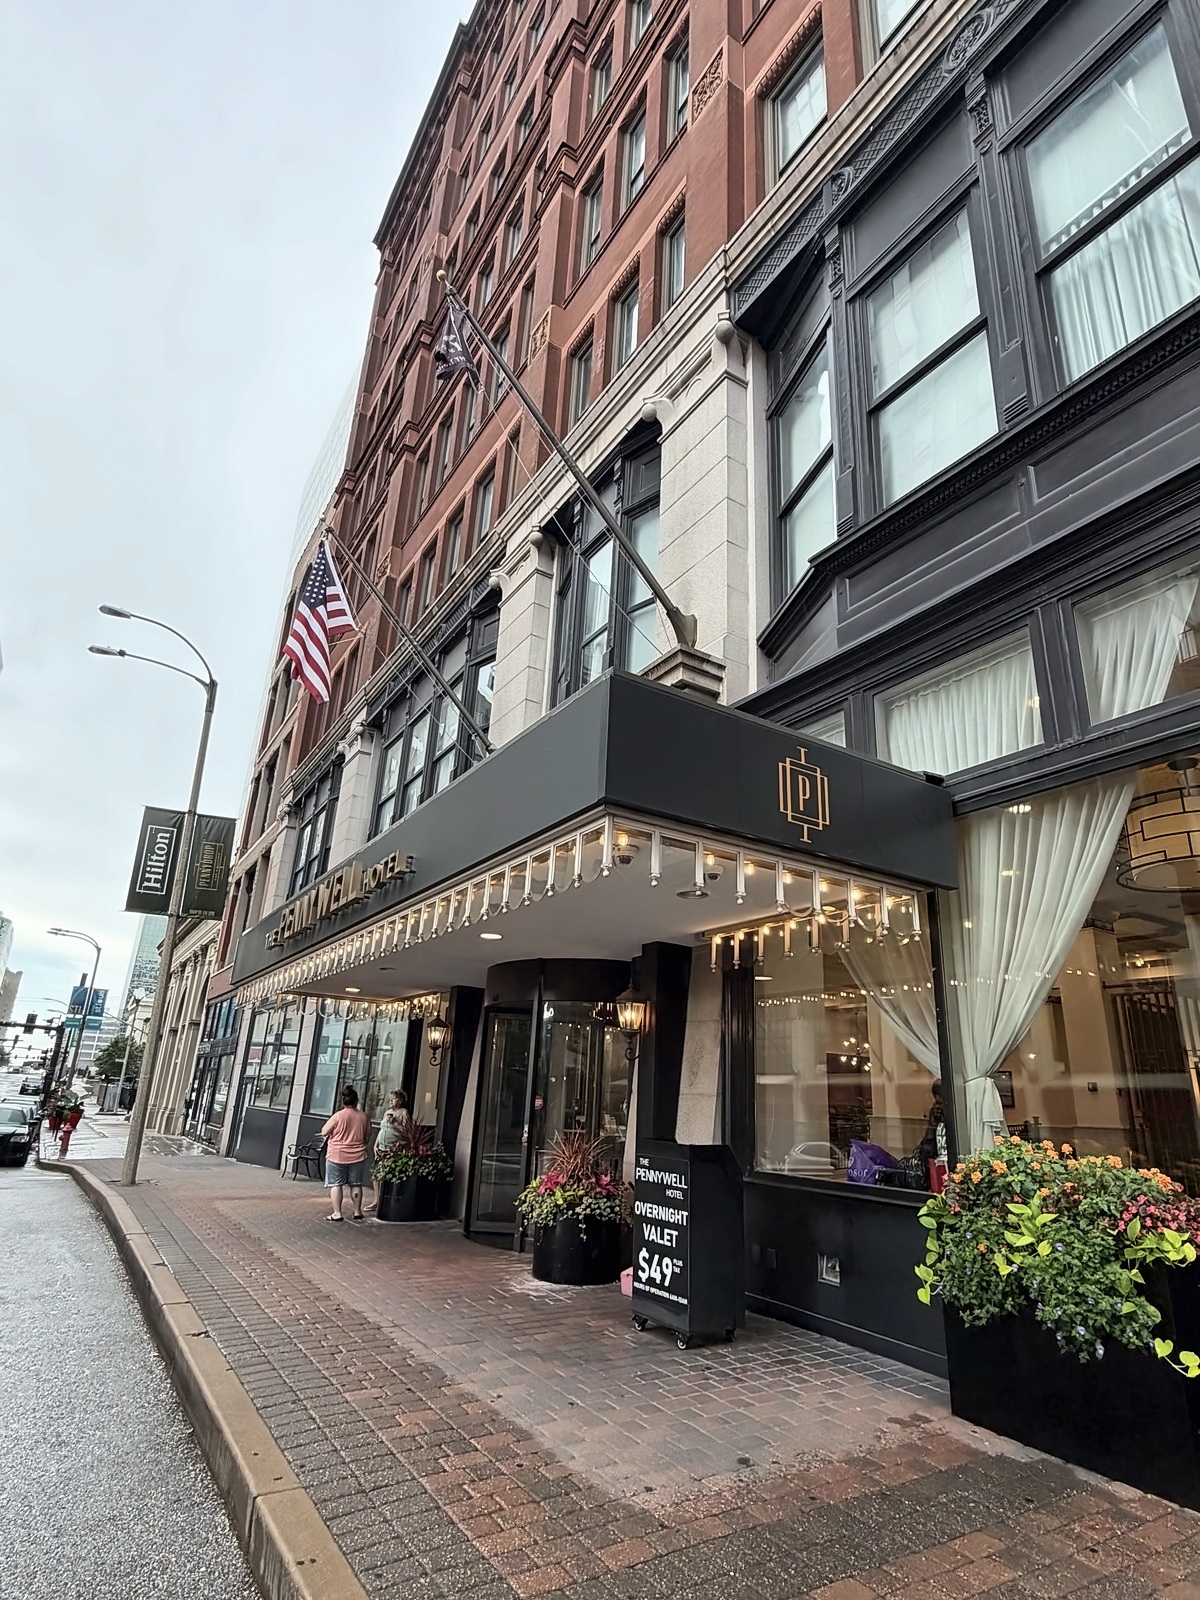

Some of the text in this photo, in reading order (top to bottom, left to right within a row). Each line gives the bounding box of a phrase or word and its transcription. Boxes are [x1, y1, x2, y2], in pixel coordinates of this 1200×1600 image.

[142, 832, 171, 889] Hilton
[363, 850, 410, 893] HOTEL
[639, 1157, 650, 1167] THE
[635, 1167, 688, 1189] PENNYWELL
[665, 1188, 684, 1200] HOTEL
[634, 1200, 689, 1226] OVERNIGHT
[642, 1222, 679, 1248] VALET
[637, 1247, 673, 1287] $49
